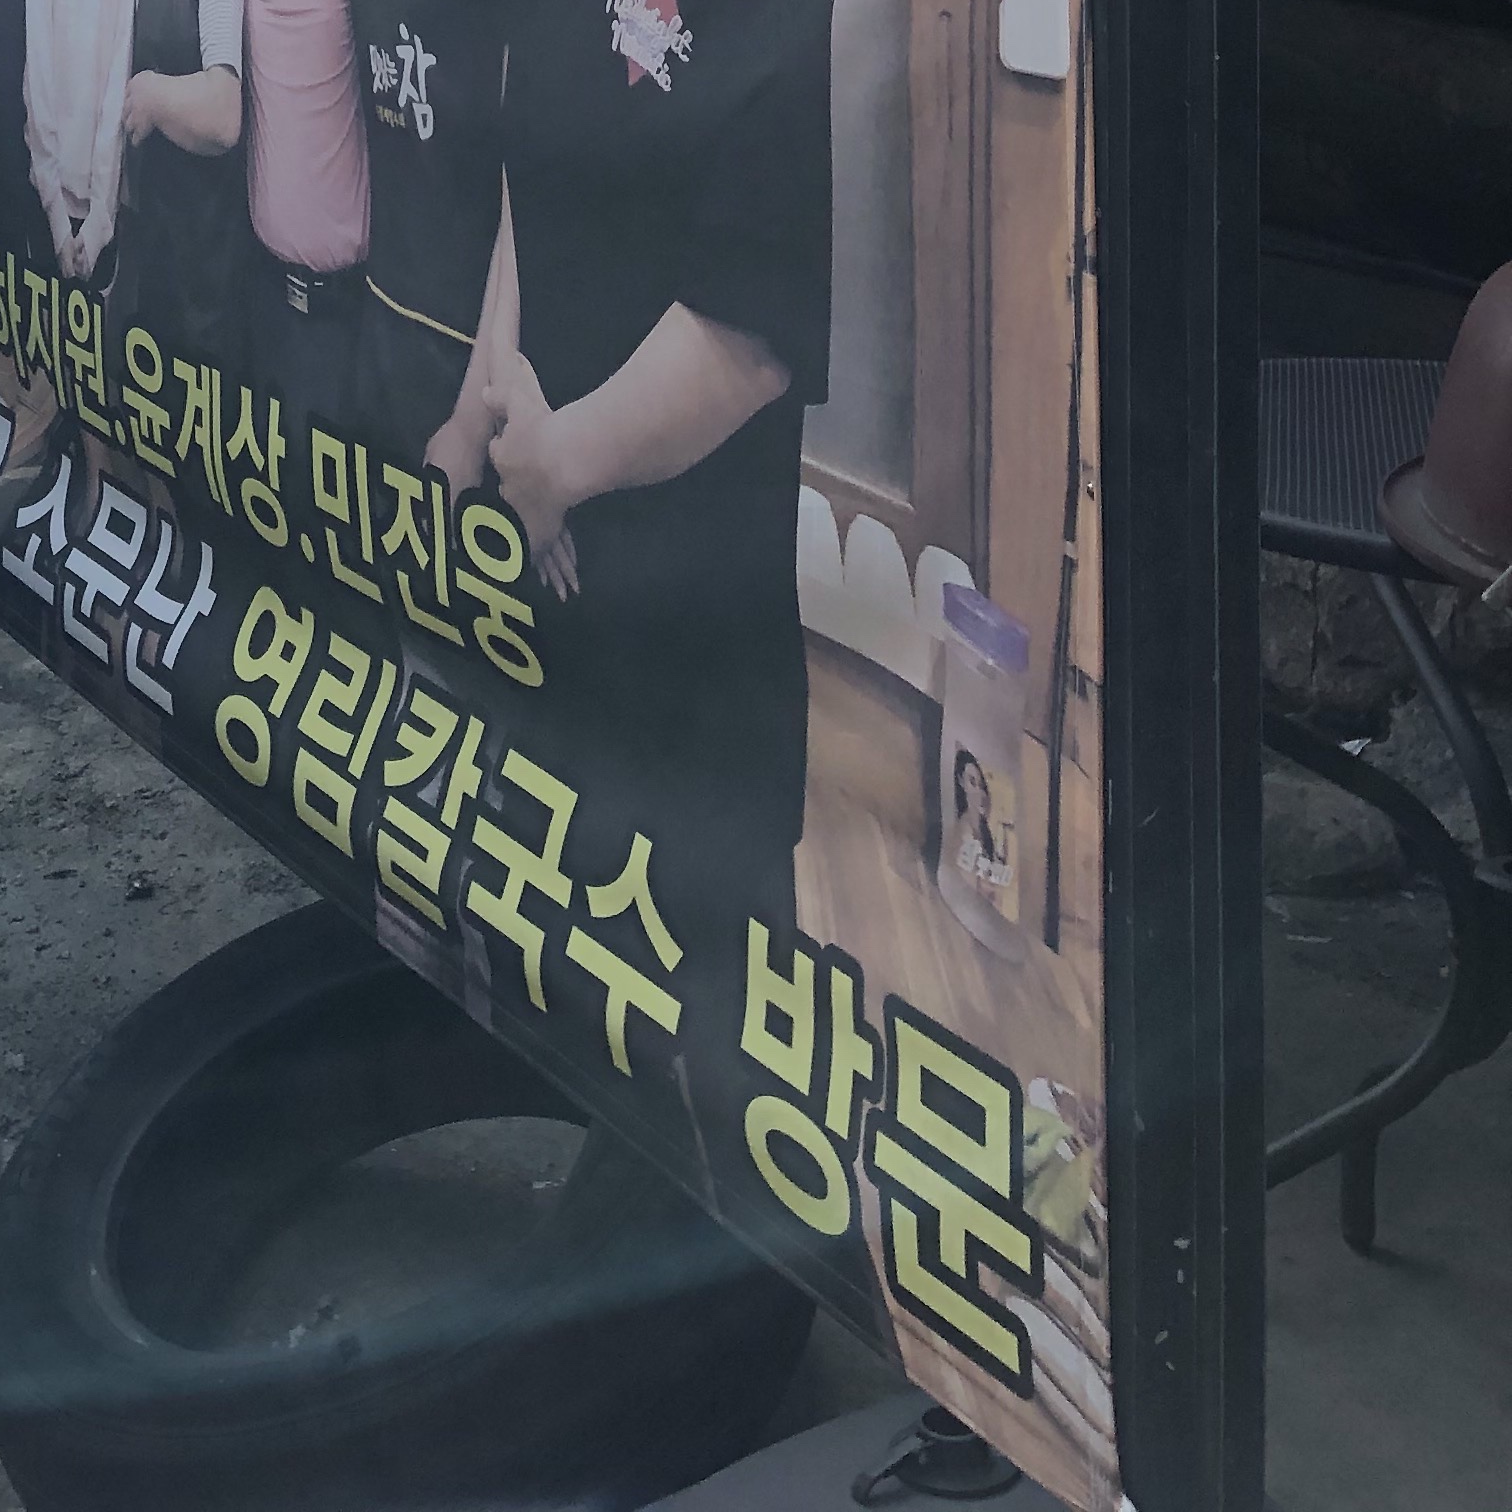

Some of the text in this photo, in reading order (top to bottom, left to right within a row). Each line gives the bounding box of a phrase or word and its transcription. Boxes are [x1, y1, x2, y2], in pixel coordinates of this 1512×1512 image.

[1, 455, 218, 716] 소문난
[214, 585, 684, 1078] 영림칼국수
[740, 917, 1032, 1375] 방문
